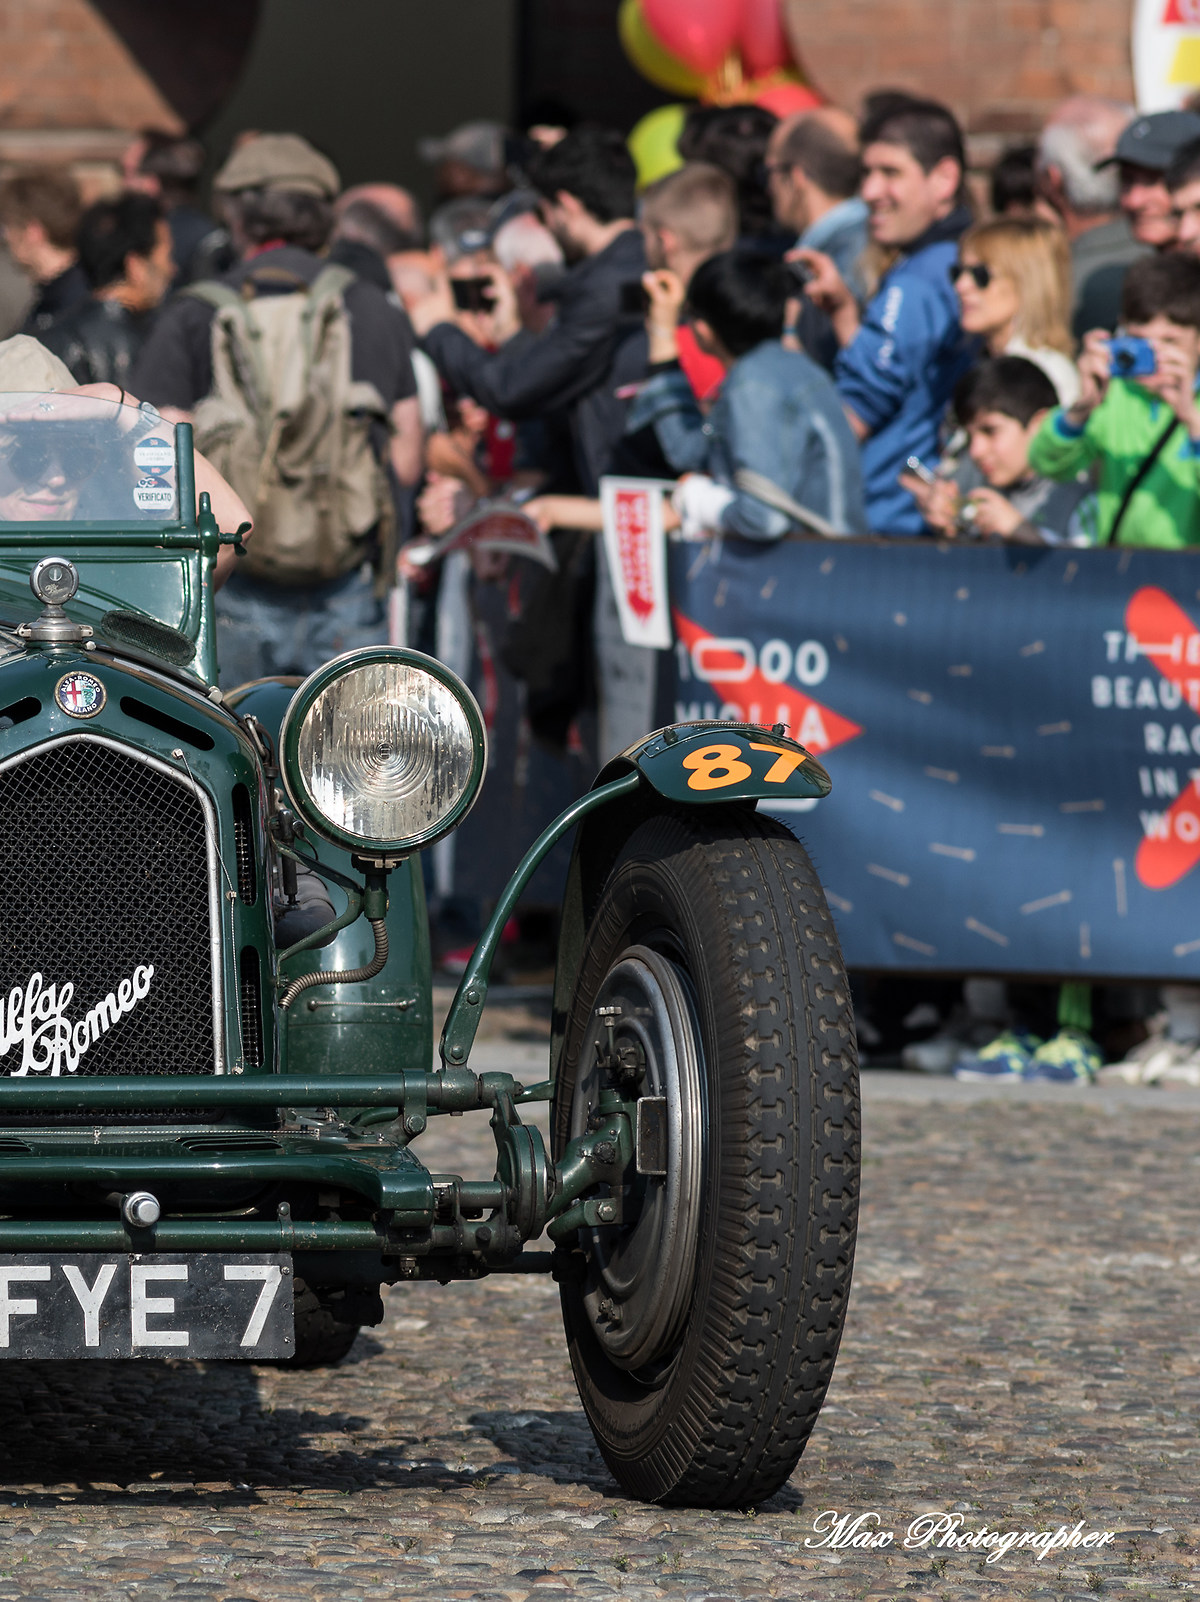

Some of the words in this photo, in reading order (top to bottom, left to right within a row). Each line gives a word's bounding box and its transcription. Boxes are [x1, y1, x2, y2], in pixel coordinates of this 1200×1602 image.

[138, 492, 171, 501] VERIFICATO
[676, 636, 829, 687] 1000
[682, 742, 808, 791] 87
[1139, 766, 1178, 798] IN
[29, 964, 154, 1077] Romeo
[223, 1264, 282, 1348] 7
